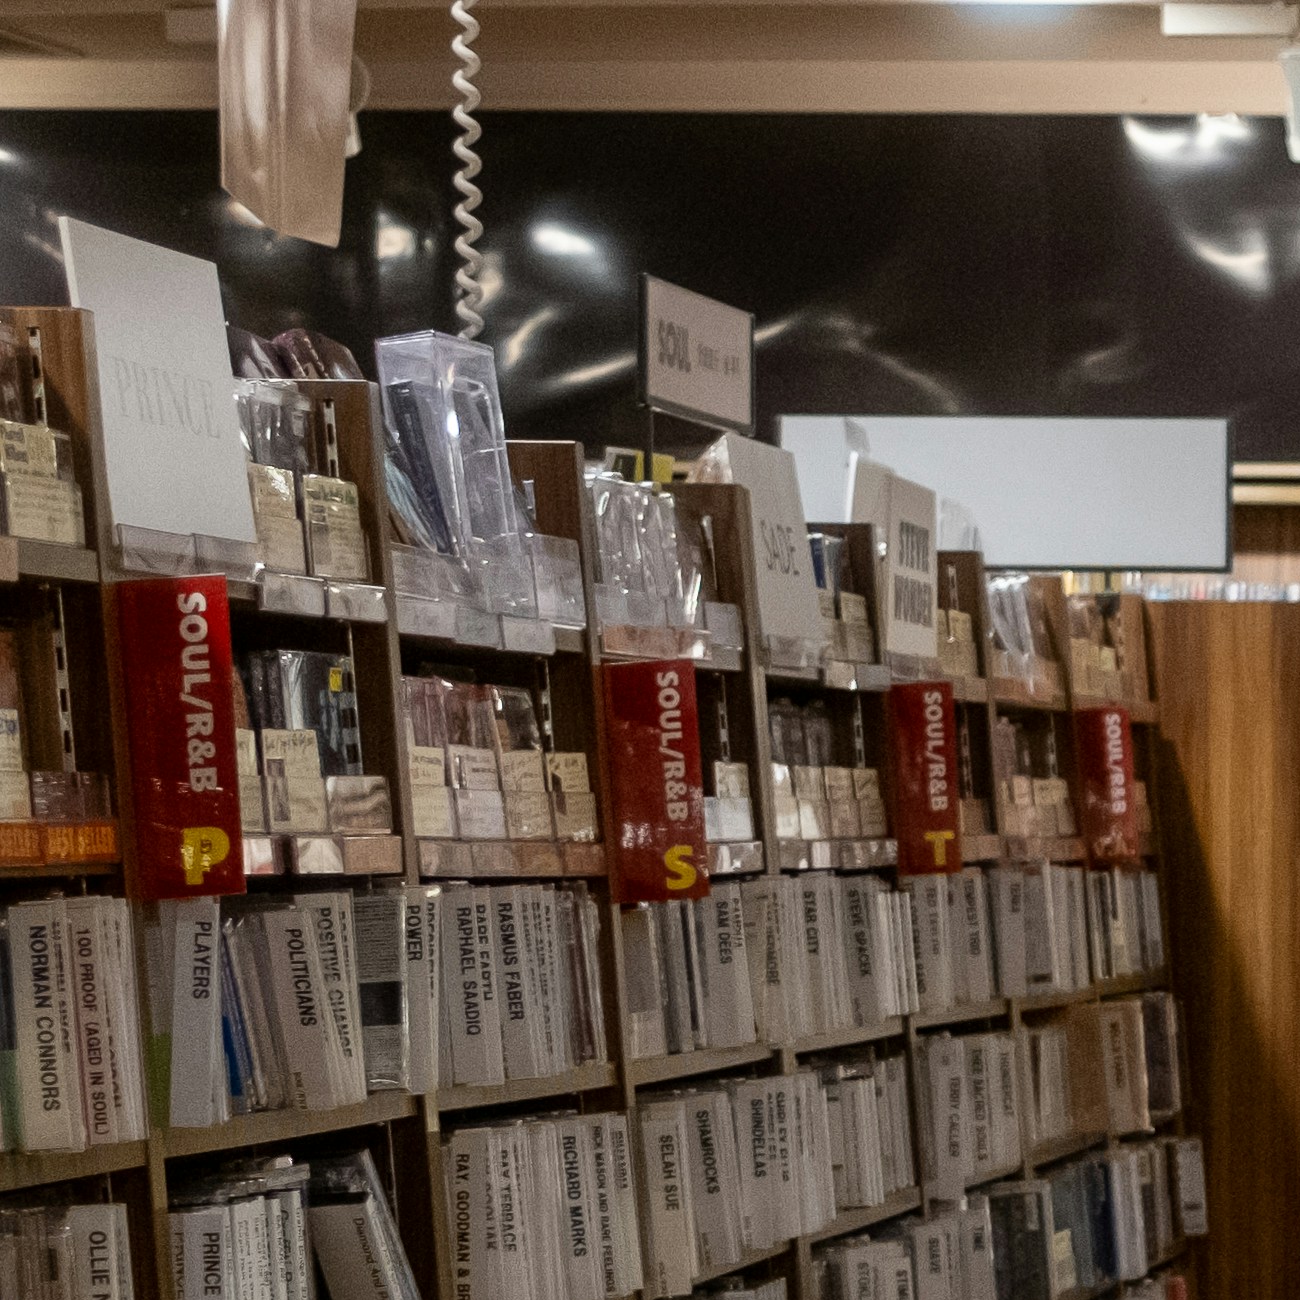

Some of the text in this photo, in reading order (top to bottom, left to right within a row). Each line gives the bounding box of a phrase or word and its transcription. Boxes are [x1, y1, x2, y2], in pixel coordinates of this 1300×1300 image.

[176, 591, 218, 793] SOUL/R&B
[656, 670, 689, 822] SOUL/R&B
[923, 690, 949, 812] SOUL/R&B
[1103, 713, 1128, 816] SOUL/R&B
[180, 826, 231, 886] P
[663, 845, 698, 891] S
[924, 830, 956, 867] T
[191, 921, 213, 1001] PLAYERS
[315, 906, 343, 982] POSITIVE
[406, 904, 424, 962] POWER
[497, 902, 525, 1022] RASMUS FABER
[716, 901, 734, 965] SAM DEES
[803, 890, 820, 956] STAR CITY
[847, 889, 874, 978] STEVE SPACEK
[29, 925, 53, 1010] NORMAN
[285, 927, 318, 1027] POLITICIANS
[457, 906, 482, 1037] RAPHAEL SAADIQ
[36, 1016, 62, 1112] CONNORS
[75, 928, 111, 1136] 100 PROOF (AGED IN SOUL)
[659, 1134, 680, 1212] SELAH SUE
[696, 1109, 721, 1195] SHAMROCKS
[749, 1097, 768, 1179] SHINDELLAS
[456, 1189, 471, 1262] GOODMAN
[562, 1135, 588, 1258] RICHARD MARKS
[88, 1229, 111, 1286] OLLIE
[202, 1231, 222, 1297] PRINCE
[458, 1268, 470, 1278] &
[927, 1236, 942, 1274] SUAVE
